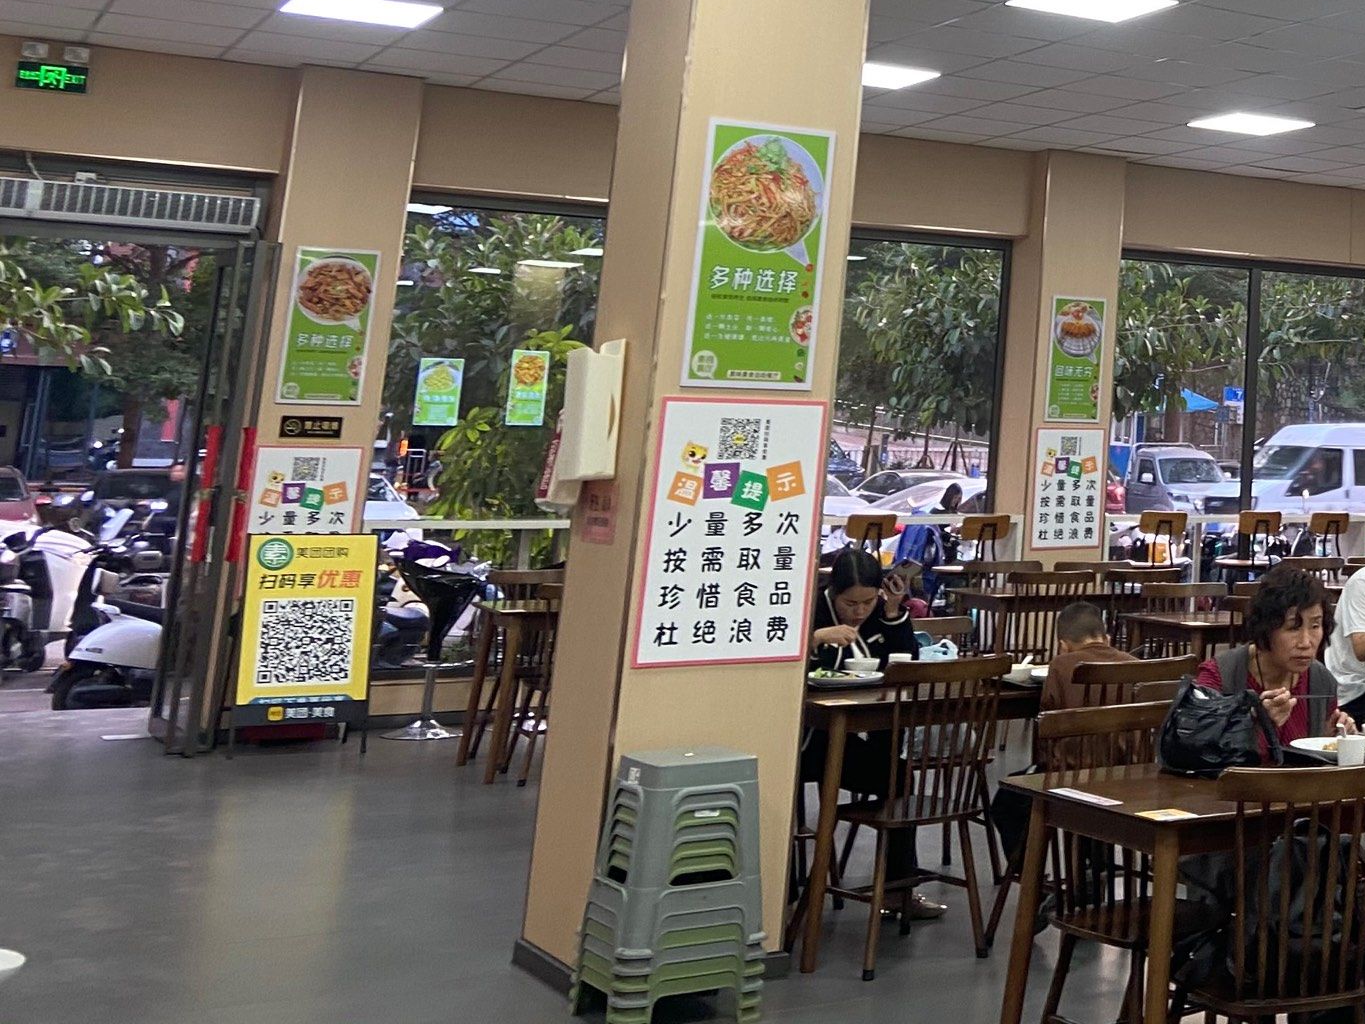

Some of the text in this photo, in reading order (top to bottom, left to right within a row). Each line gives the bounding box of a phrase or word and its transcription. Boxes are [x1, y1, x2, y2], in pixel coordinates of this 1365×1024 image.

[709, 266, 798, 293] 多种选择
[674, 470, 797, 502] 温馨提示
[1041, 479, 1096, 492] 少量多次
[1039, 495, 1095, 508] 按需取量
[258, 510, 346, 526] 少量多次
[668, 511, 800, 538] 少量多次
[1039, 511, 1094, 524] 珍惜食品
[1038, 527, 1093, 540] 杜绝浪费
[296, 546, 349, 559] 美团团购
[662, 546, 796, 574] 按需取量
[259, 570, 363, 590] 扫码享优惠
[657, 581, 792, 610] 珍惜食品
[653, 616, 789, 647] 杜绝浪费
